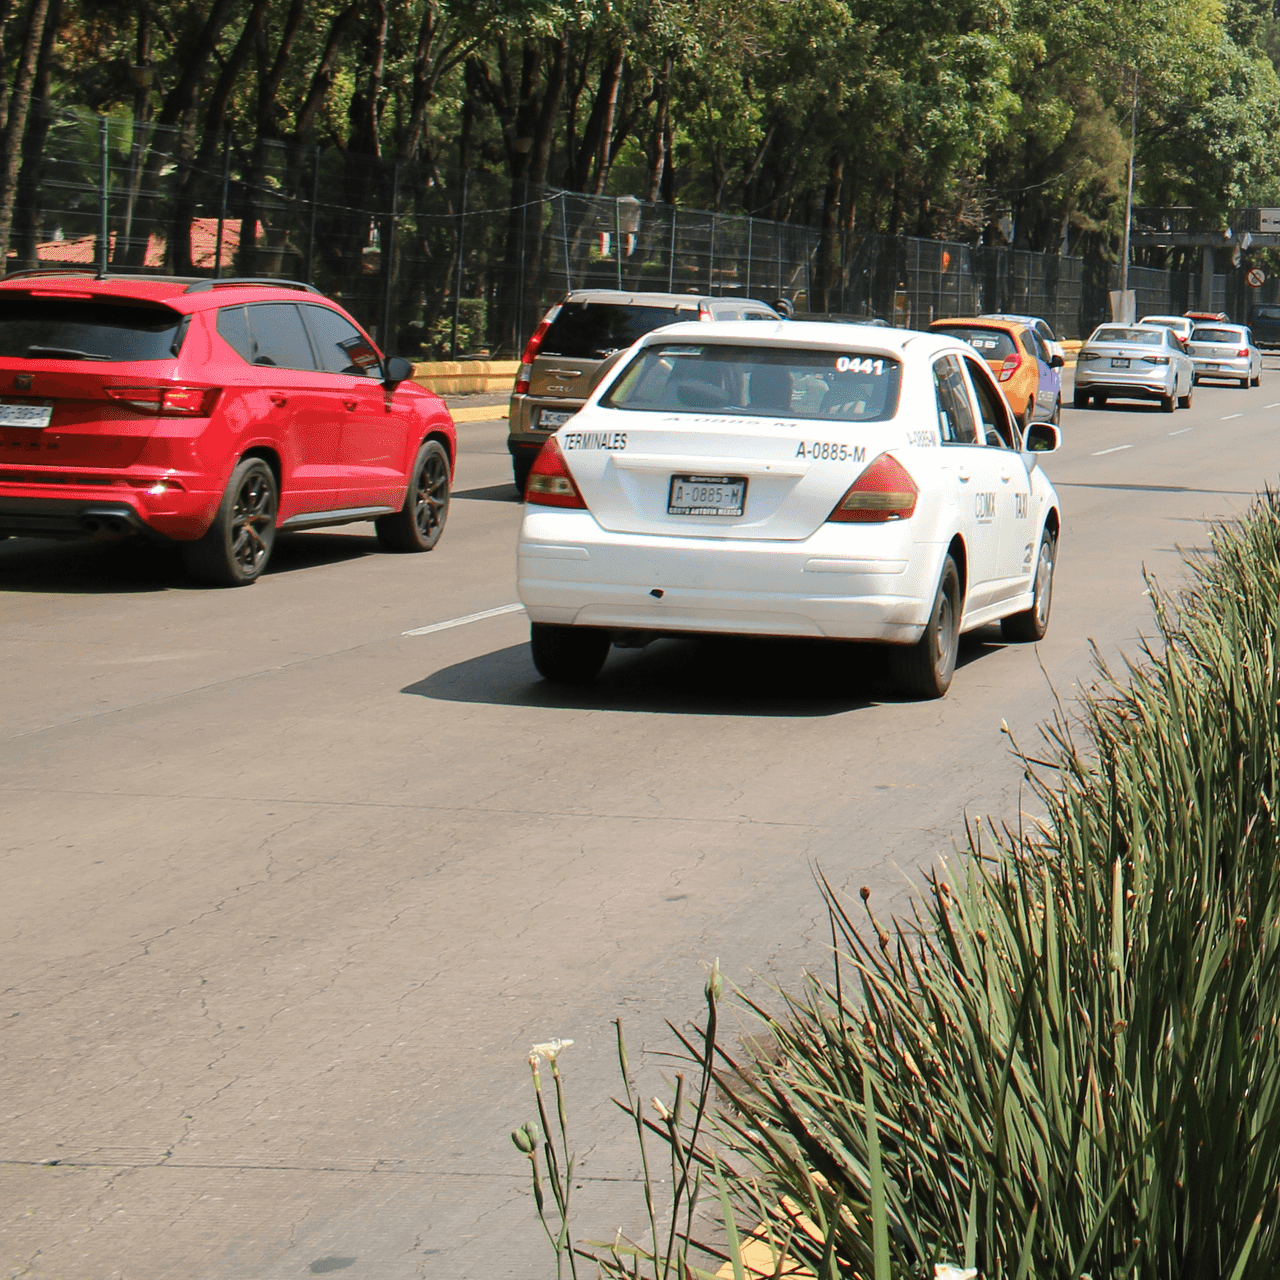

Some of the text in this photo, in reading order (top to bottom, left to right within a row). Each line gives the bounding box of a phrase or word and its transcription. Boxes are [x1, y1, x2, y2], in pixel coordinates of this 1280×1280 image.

[836, 357, 884, 375] 0441
[563, 433, 628, 450] TERMINALES
[796, 441, 866, 462] A-0885-M
[675, 486, 740, 504] A-0885-M
[976, 492, 996, 518] CDMX
[1015, 492, 1028, 519] TAXI
